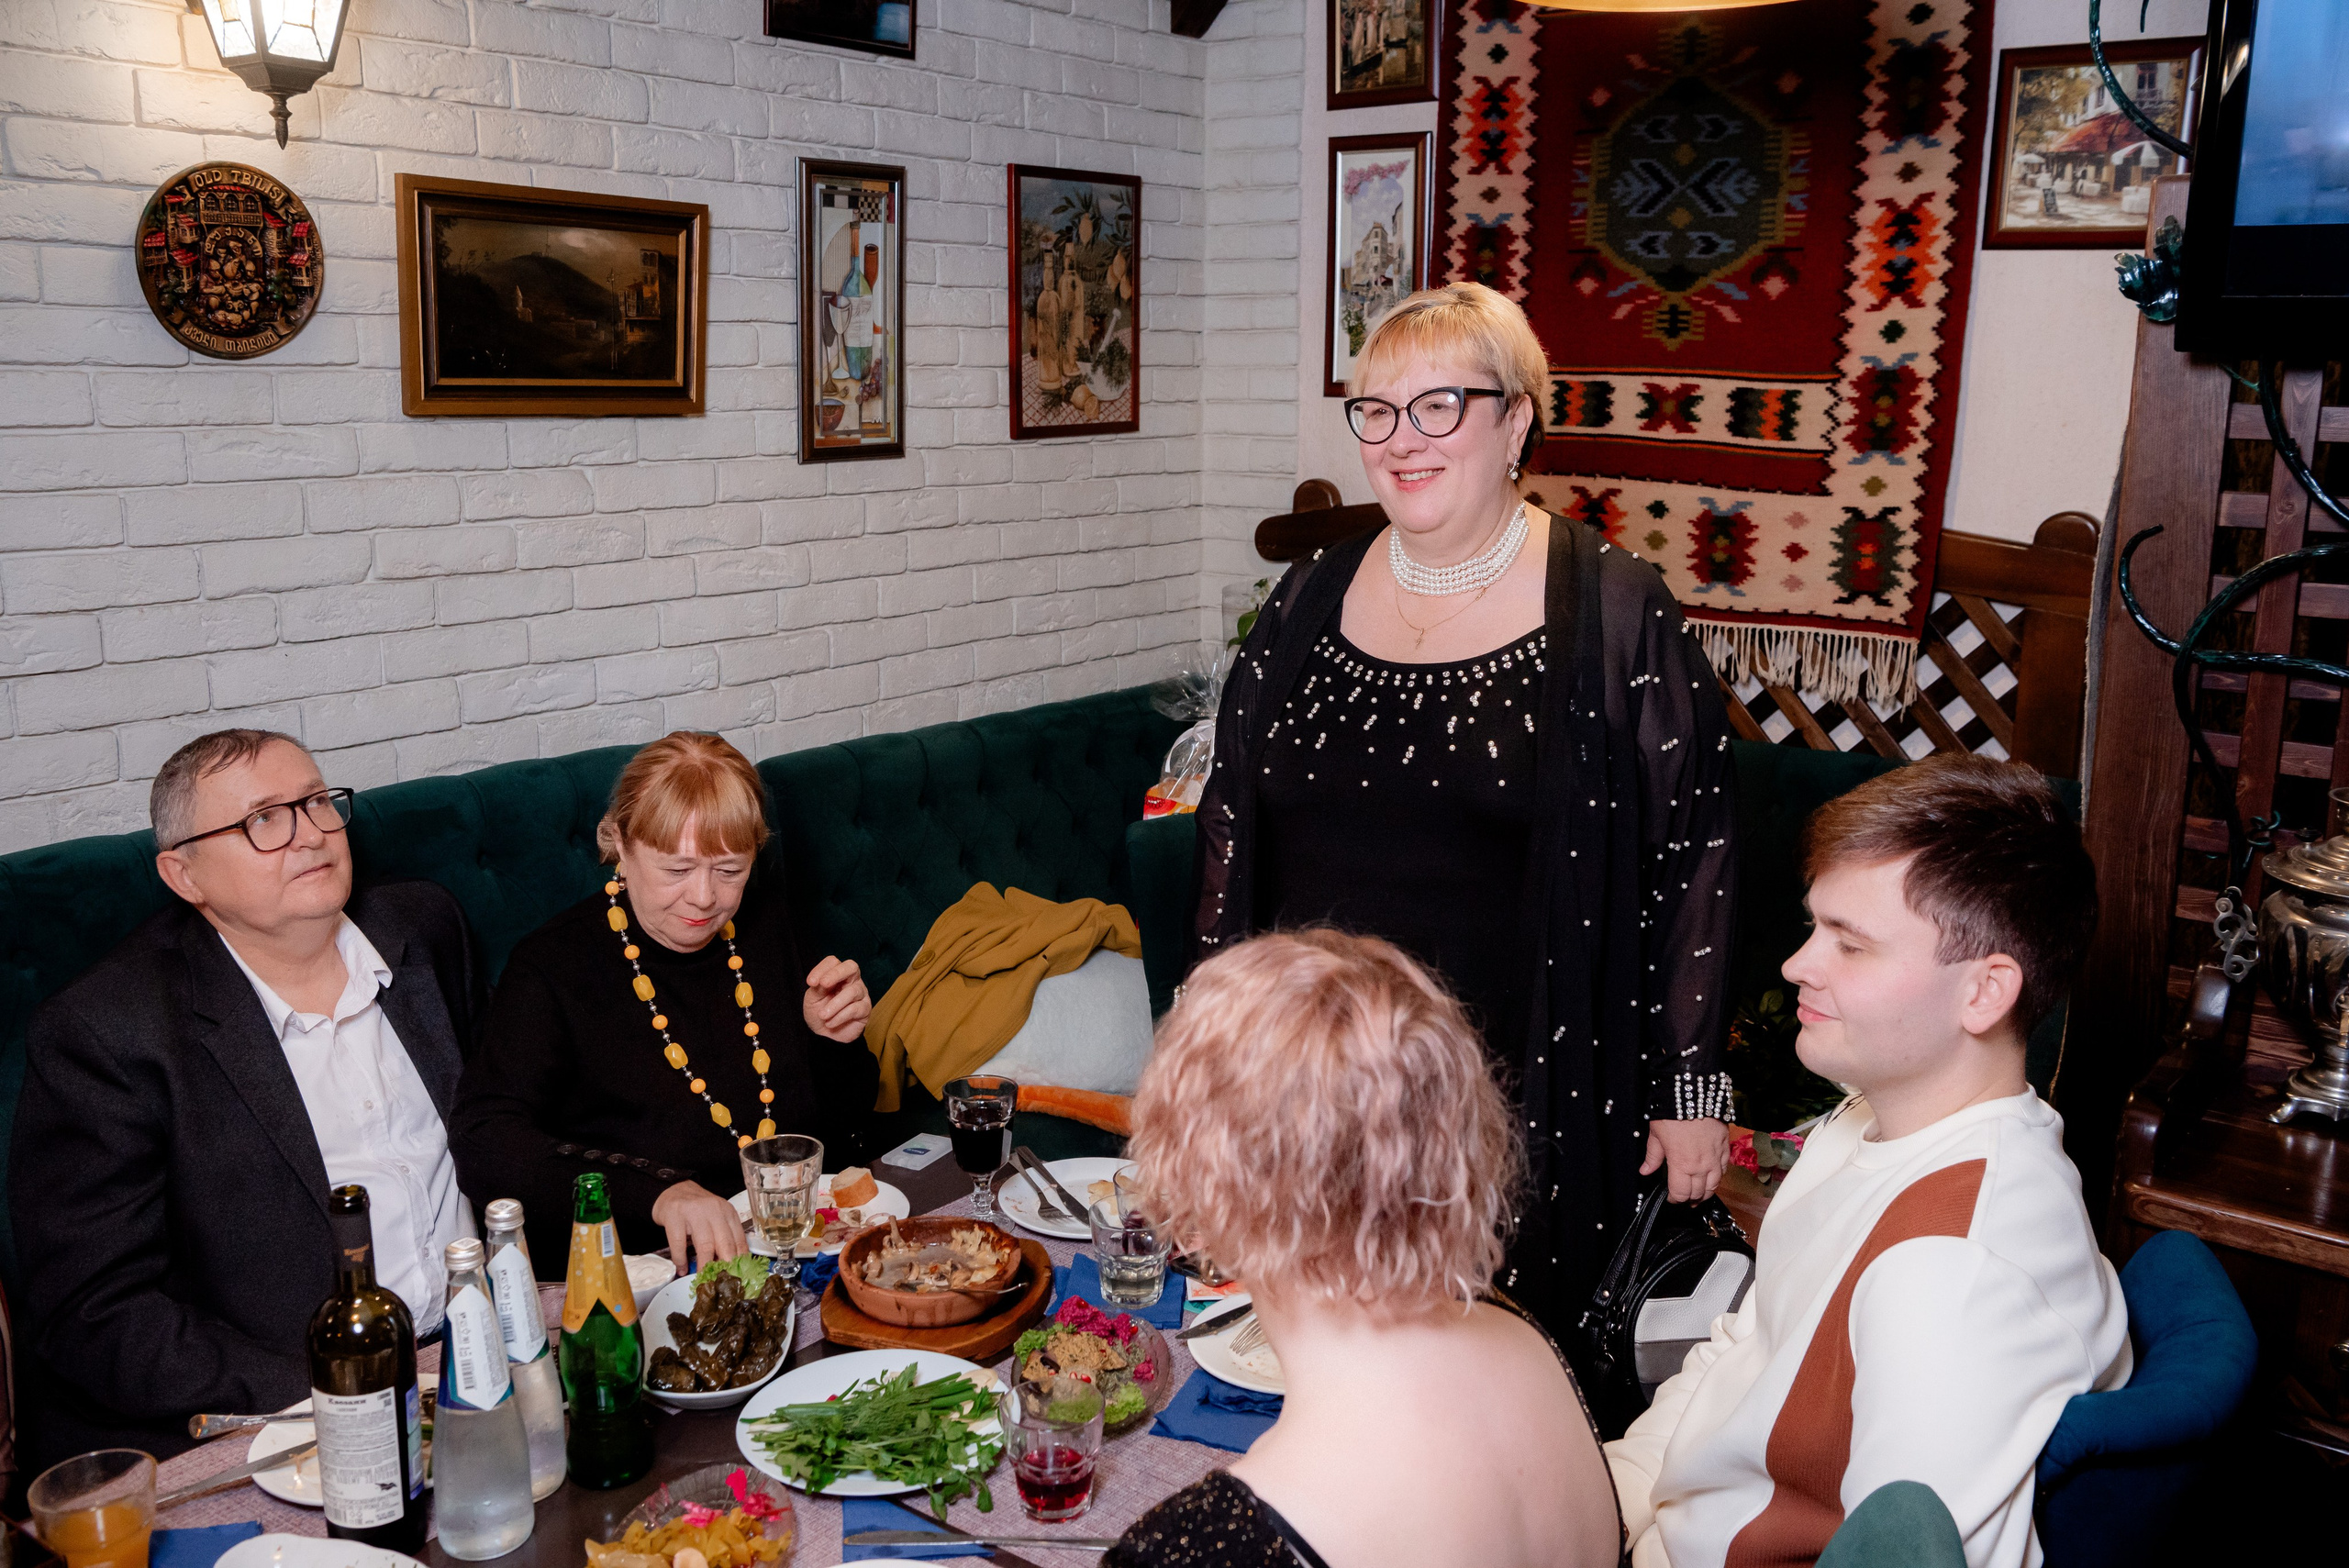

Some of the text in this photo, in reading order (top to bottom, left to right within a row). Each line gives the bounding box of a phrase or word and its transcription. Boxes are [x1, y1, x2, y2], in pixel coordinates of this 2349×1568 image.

[195, 170, 287, 203] OLD TBILISI
[225, 331, 276, 353] თბილისი
